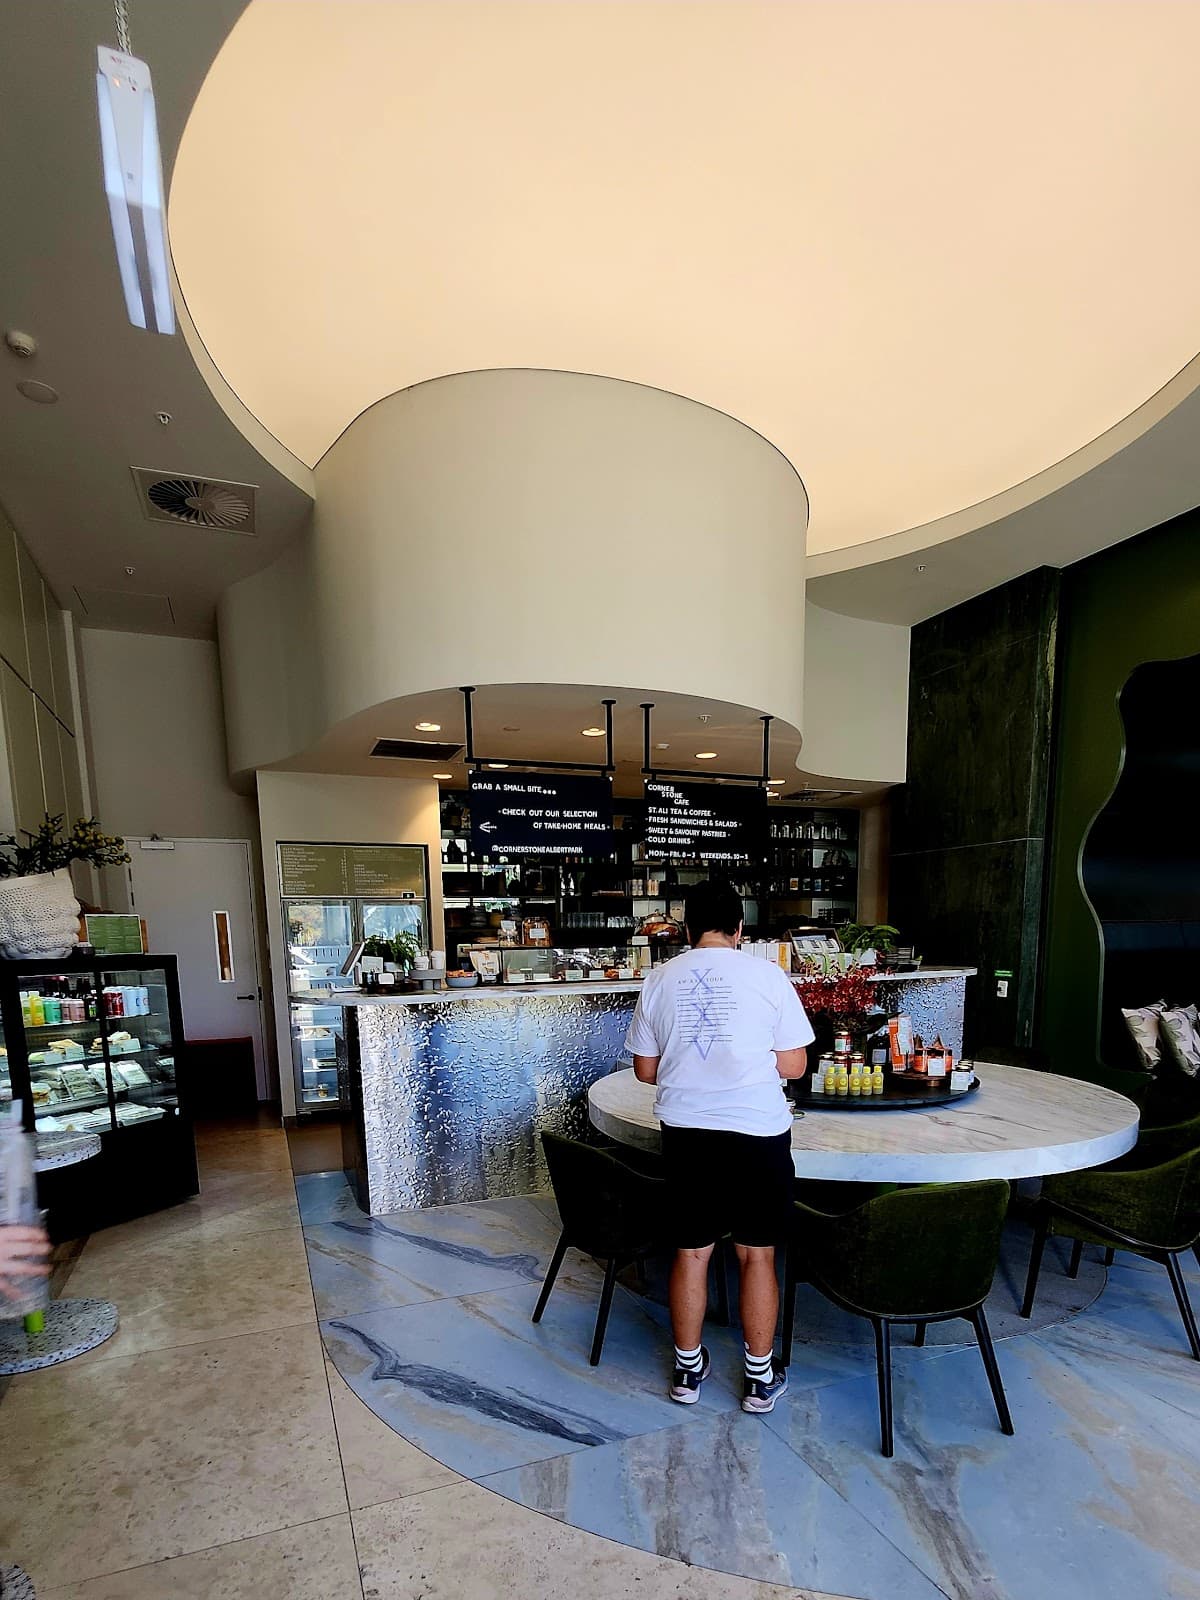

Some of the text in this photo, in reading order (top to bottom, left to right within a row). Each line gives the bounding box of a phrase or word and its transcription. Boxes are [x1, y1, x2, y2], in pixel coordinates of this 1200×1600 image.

[495, 783, 501, 791] A
[503, 784, 526, 792] SMALL
[648, 784, 675, 792] CORNER
[661, 791, 684, 799] STONE
[674, 798, 690, 806] CAFE
[502, 808, 526, 816] CHECK
[529, 809, 543, 817] OUT
[562, 810, 598, 818] SELECTION
[533, 822, 542, 830] OF
[648, 816, 669, 824] FRESH
[670, 817, 708, 826] SANDWICHES
[715, 820, 738, 828] SALADS
[675, 828, 700, 836] SAVOURY
[701, 830, 727, 838] PASTRIES
[668, 837, 691, 845] DRINKS
[491, 845, 583, 854] @CORNERSTONEALBERTPARK
